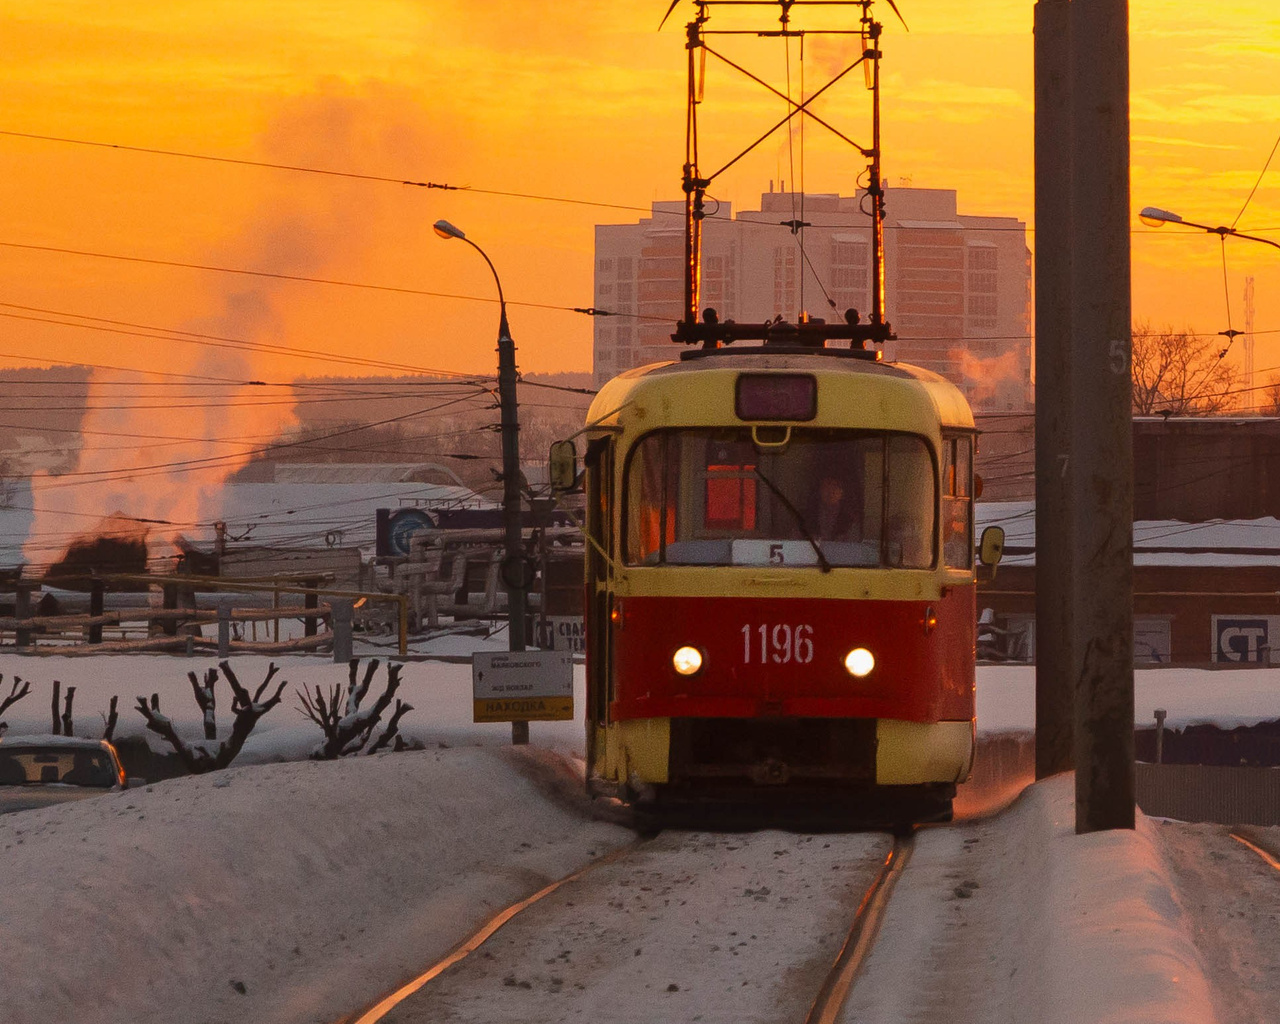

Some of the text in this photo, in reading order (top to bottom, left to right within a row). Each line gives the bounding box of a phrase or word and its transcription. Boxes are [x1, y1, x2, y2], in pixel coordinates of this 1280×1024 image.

[1109, 339, 1127, 375] 5
[1057, 454, 1070, 478] 7
[769, 543, 784, 565] 5
[741, 623, 814, 664] 1196
[486, 700, 546, 713] НАХОДКА
